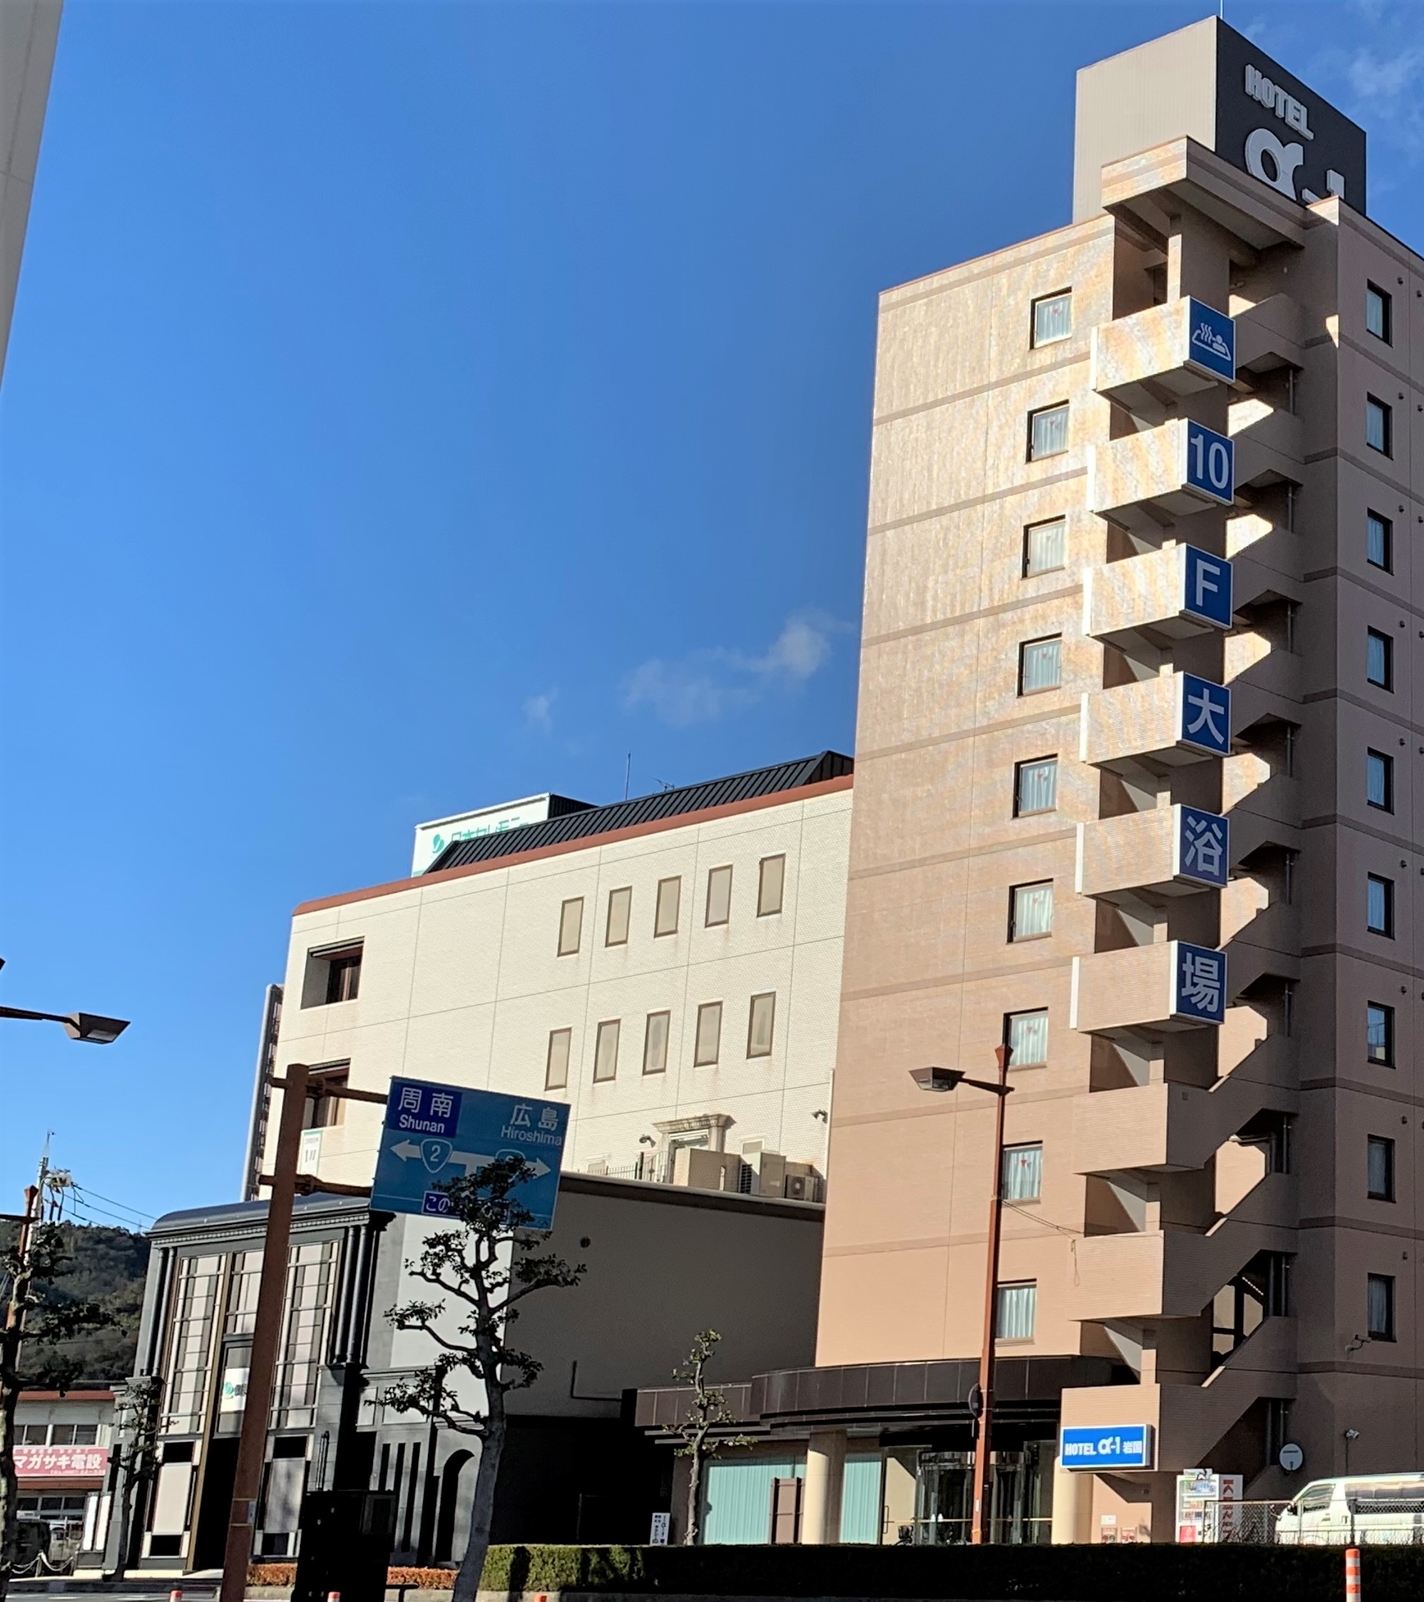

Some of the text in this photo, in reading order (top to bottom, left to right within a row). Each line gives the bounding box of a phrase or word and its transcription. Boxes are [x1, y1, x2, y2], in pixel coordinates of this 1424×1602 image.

[1245, 64, 1314, 140] HOTEL
[1190, 434, 1229, 489] 10
[1196, 559, 1221, 606] F
[1187, 688, 1225, 745] 大
[1185, 815, 1223, 876] 浴
[1181, 952, 1220, 1013] 場
[398, 1087, 454, 1118] 周南
[510, 1103, 559, 1131] 広島
[399, 1114, 445, 1133] Shunan
[500, 1125, 562, 1146] Hiroshima
[430, 1145, 441, 1161] 2
[1064, 1442, 1097, 1456] HOTEL
[1122, 1440, 1143, 1455] 岩国
